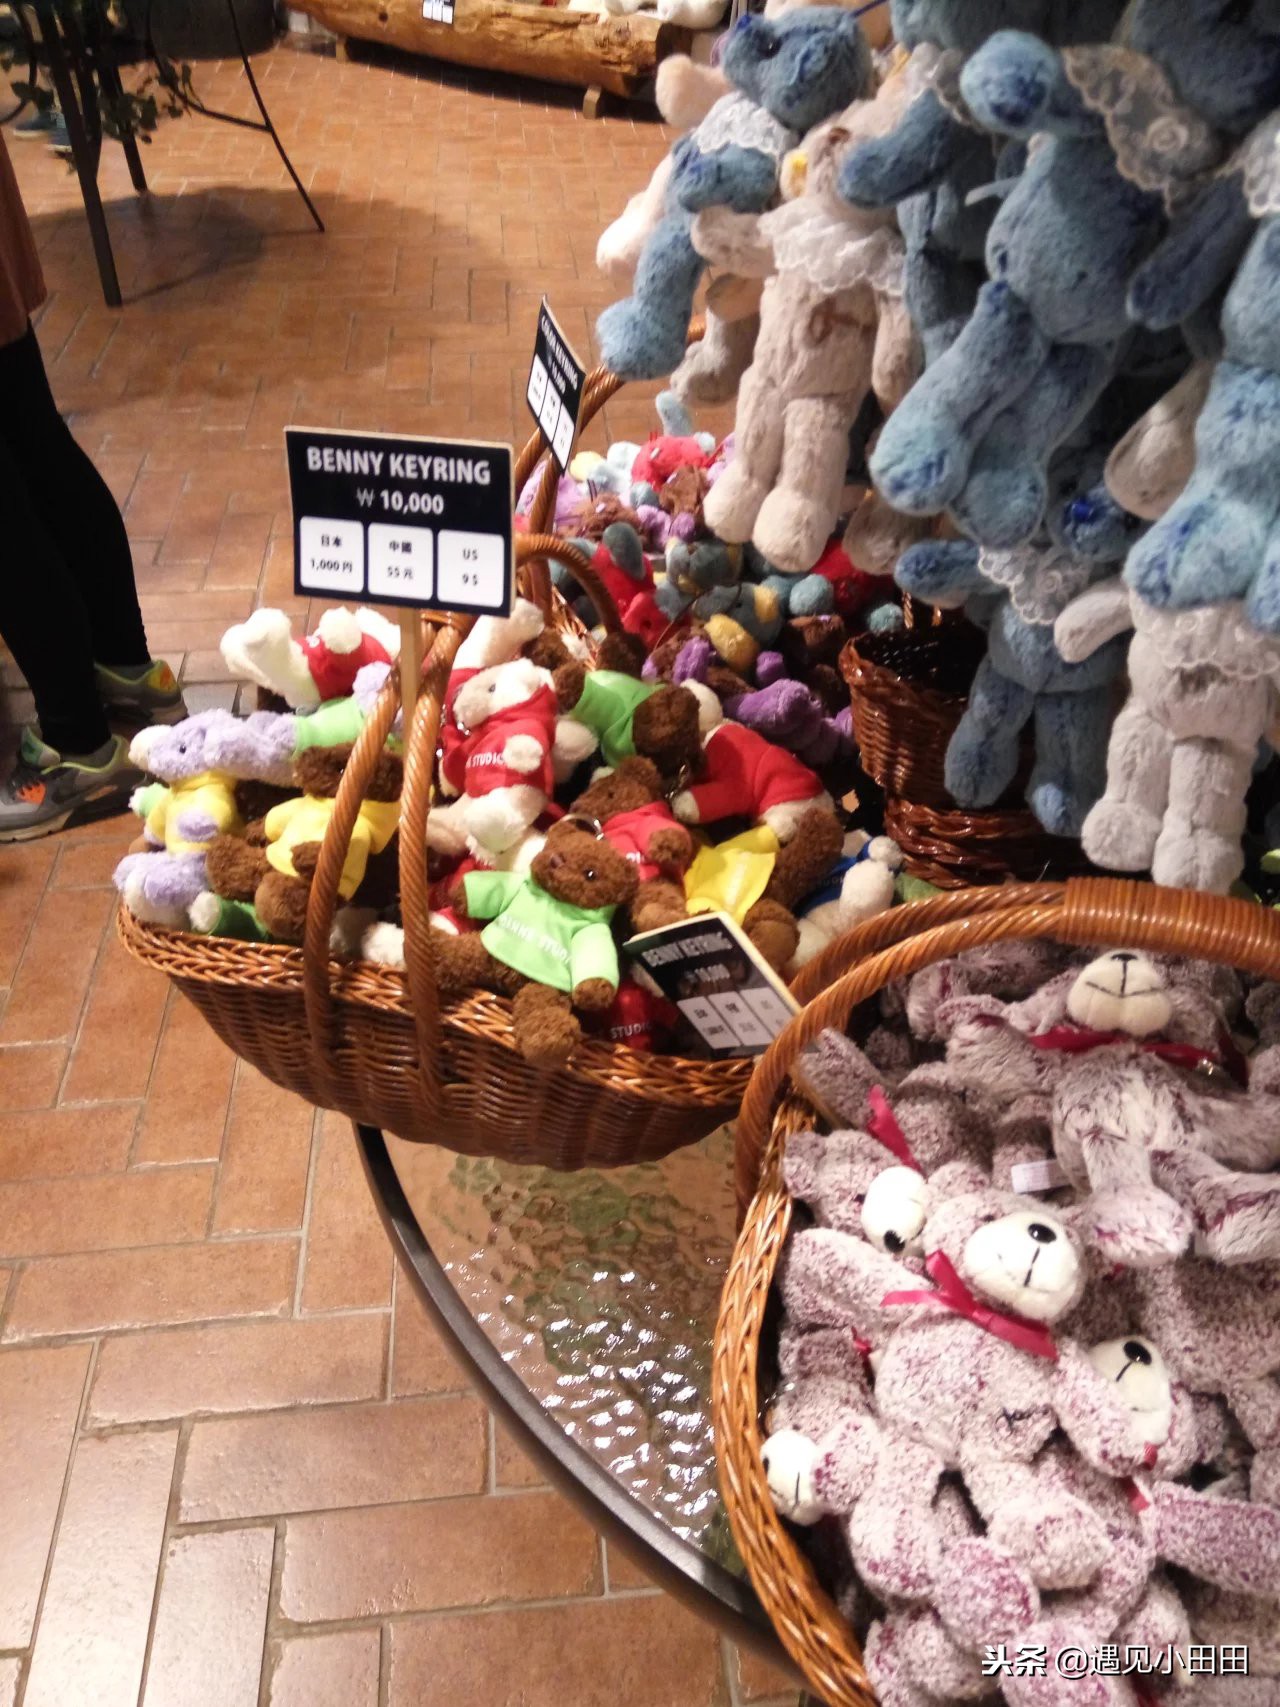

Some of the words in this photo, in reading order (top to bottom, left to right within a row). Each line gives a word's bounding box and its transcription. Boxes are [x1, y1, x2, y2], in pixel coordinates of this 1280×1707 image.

[307, 446, 384, 476] BENNY
[390, 453, 491, 485] KEYRING
[380, 490, 444, 515] 10,000
[321, 534, 342, 547] 日本
[462, 548, 478, 560] US
